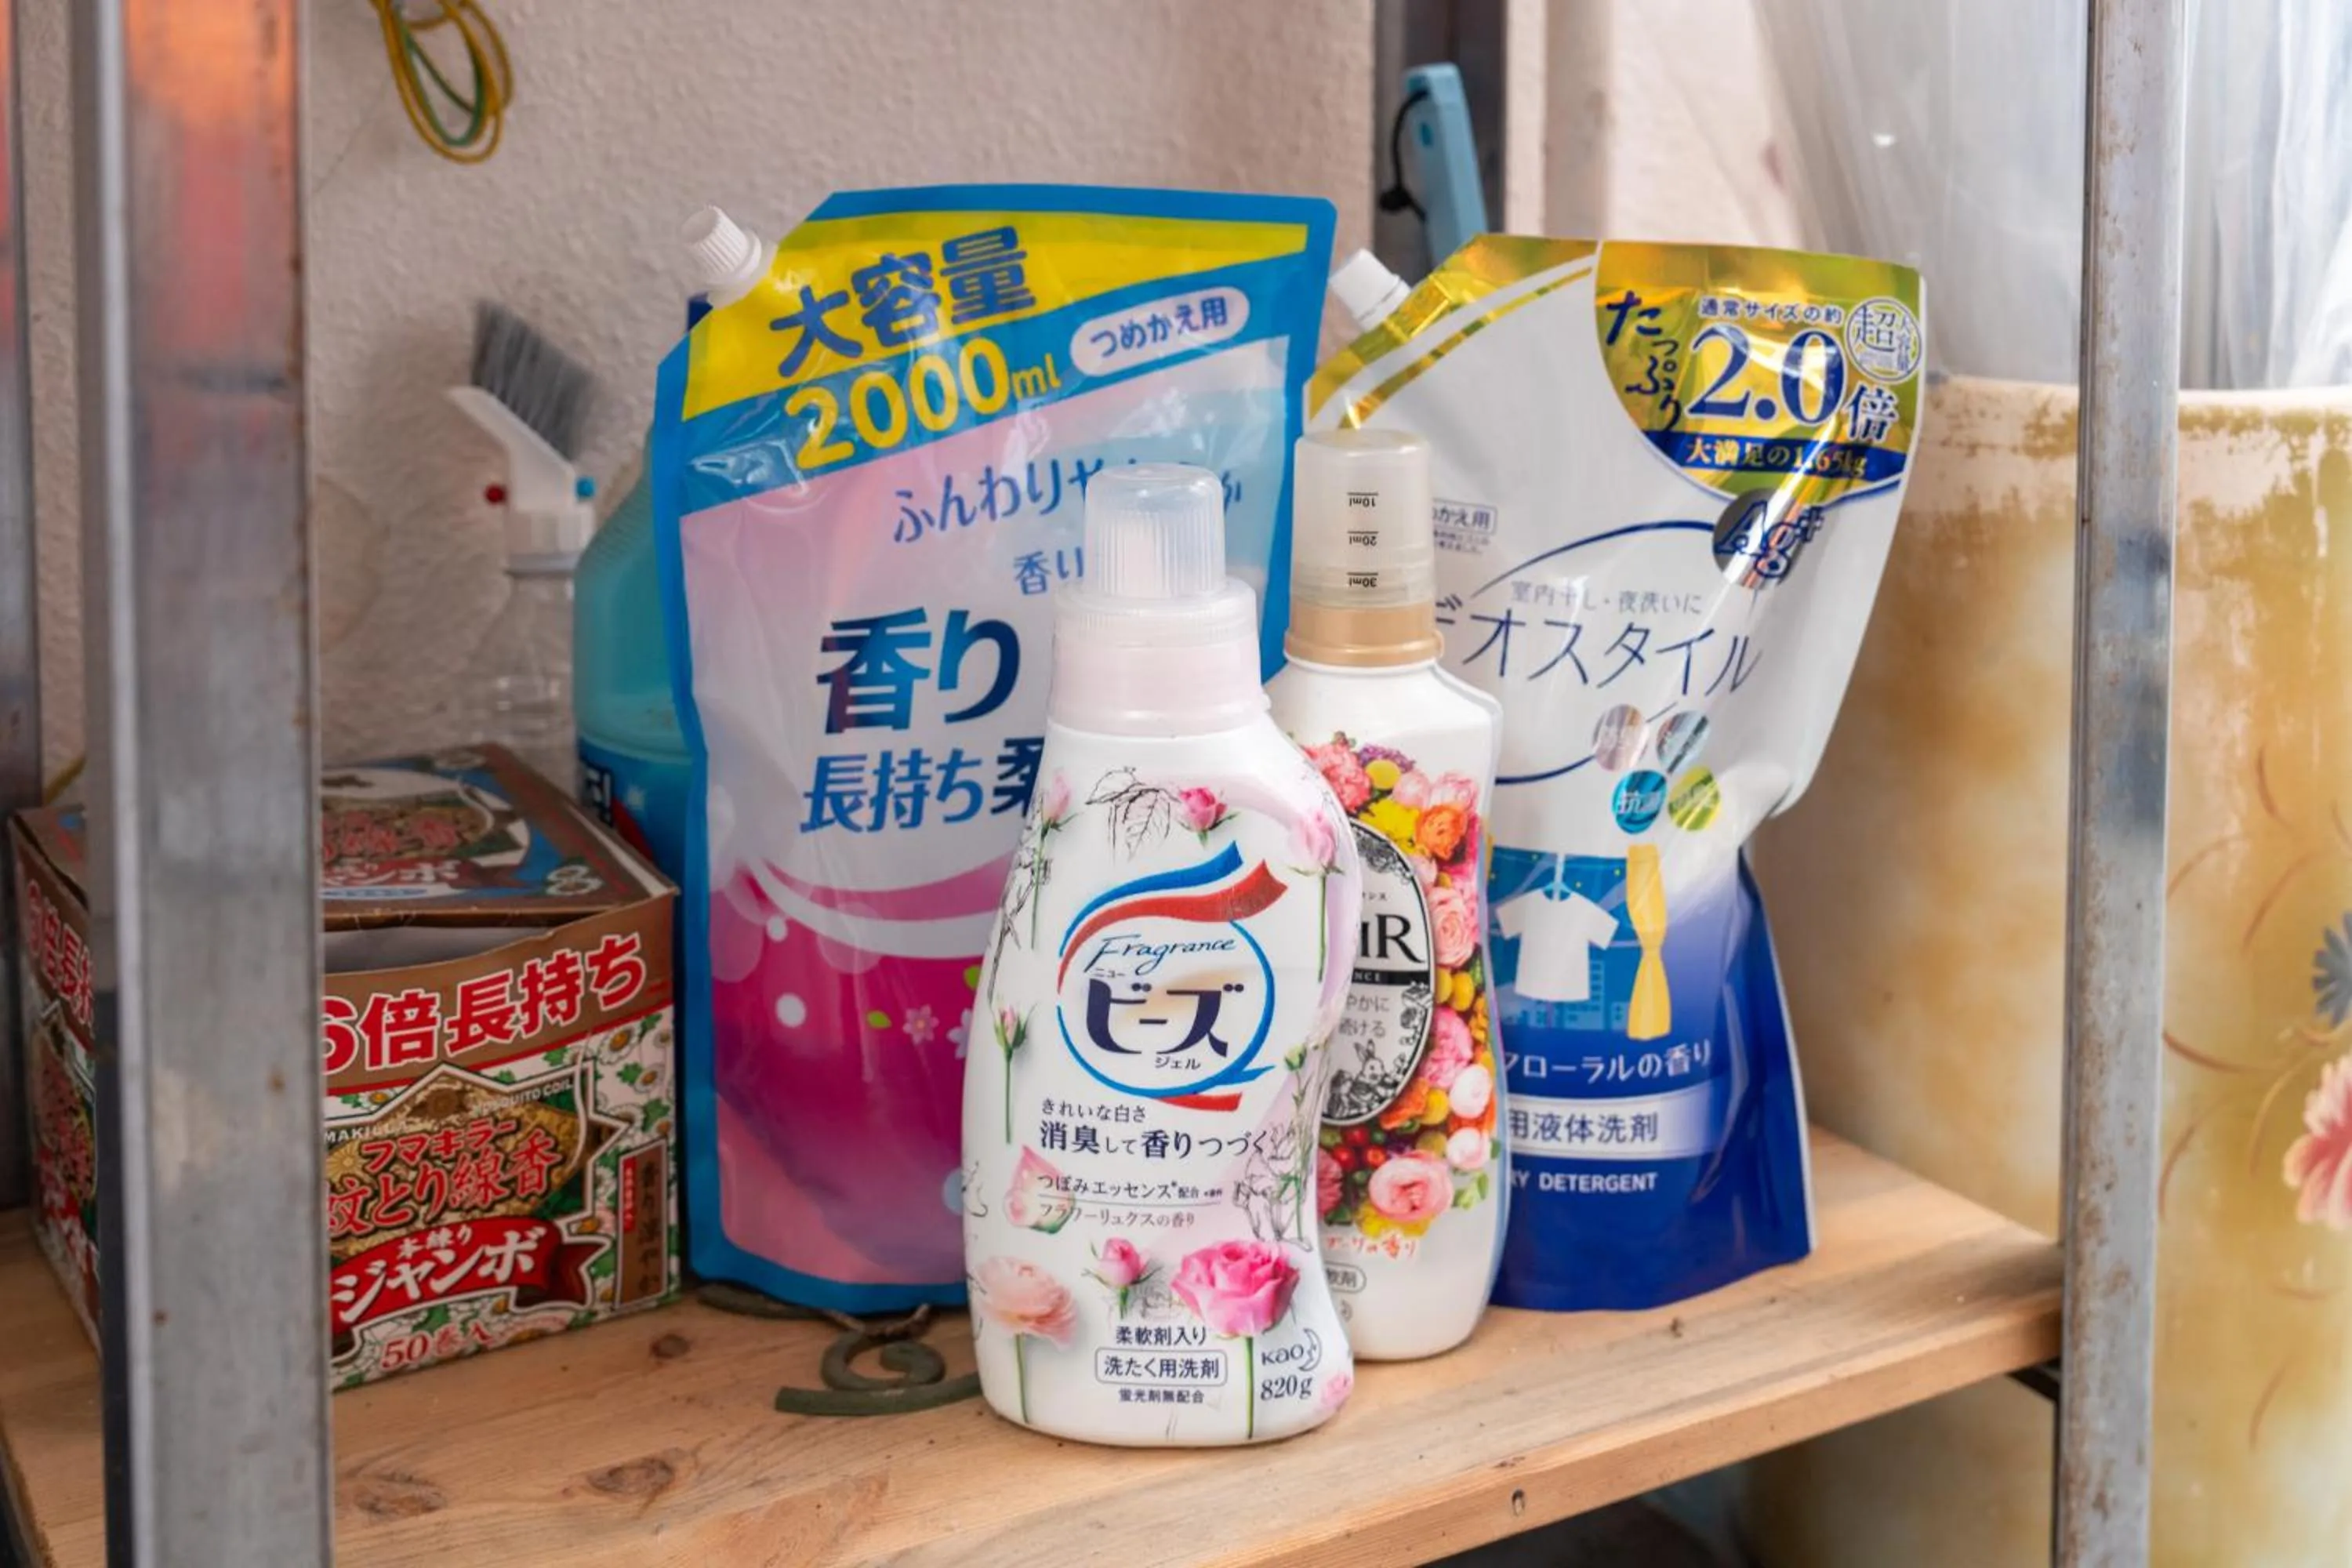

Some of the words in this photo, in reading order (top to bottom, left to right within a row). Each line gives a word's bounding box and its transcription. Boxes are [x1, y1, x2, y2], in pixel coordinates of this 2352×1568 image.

[769, 226, 1036, 378] 大容量
[1700, 298, 1843, 325] 通常サイズの約
[1089, 296, 1229, 358] つめかえ用
[1853, 304, 1896, 353] 超
[1606, 290, 1683, 431] たっぷり
[1687, 323, 1899, 441] 2.0倍
[785, 338, 1061, 470] 2000ml
[1348, 497, 1377, 508] 10ml
[1432, 506, 1490, 530] かえ用
[1348, 536, 1377, 546] 20ml
[1348, 576, 1377, 587] 30ml
[817, 607, 1021, 735] 香り
[1083, 933, 1236, 976] Fragrance
[1086, 978, 1245, 1058] ビーズ
[1154, 1056, 1202, 1070] ジェル
[1040, 1099, 1147, 1123] きれいな白さ
[1508, 1108, 1659, 1143] 用液体洗剤
[361, 1116, 517, 1174] フマキラー
[1040, 1121, 1267, 1160] 消臭して香りつづく
[1538, 1172, 1658, 1193] DETERGENT
[1040, 1203, 1196, 1228] フラワーリュクスの香り
[331, 1226, 548, 1323] ジャンボ
[1115, 1324, 1207, 1347] 柔軟剤入り
[1104, 1355, 1220, 1381] 洗たく用洗剤
[1260, 1374, 1313, 1401] 820g
